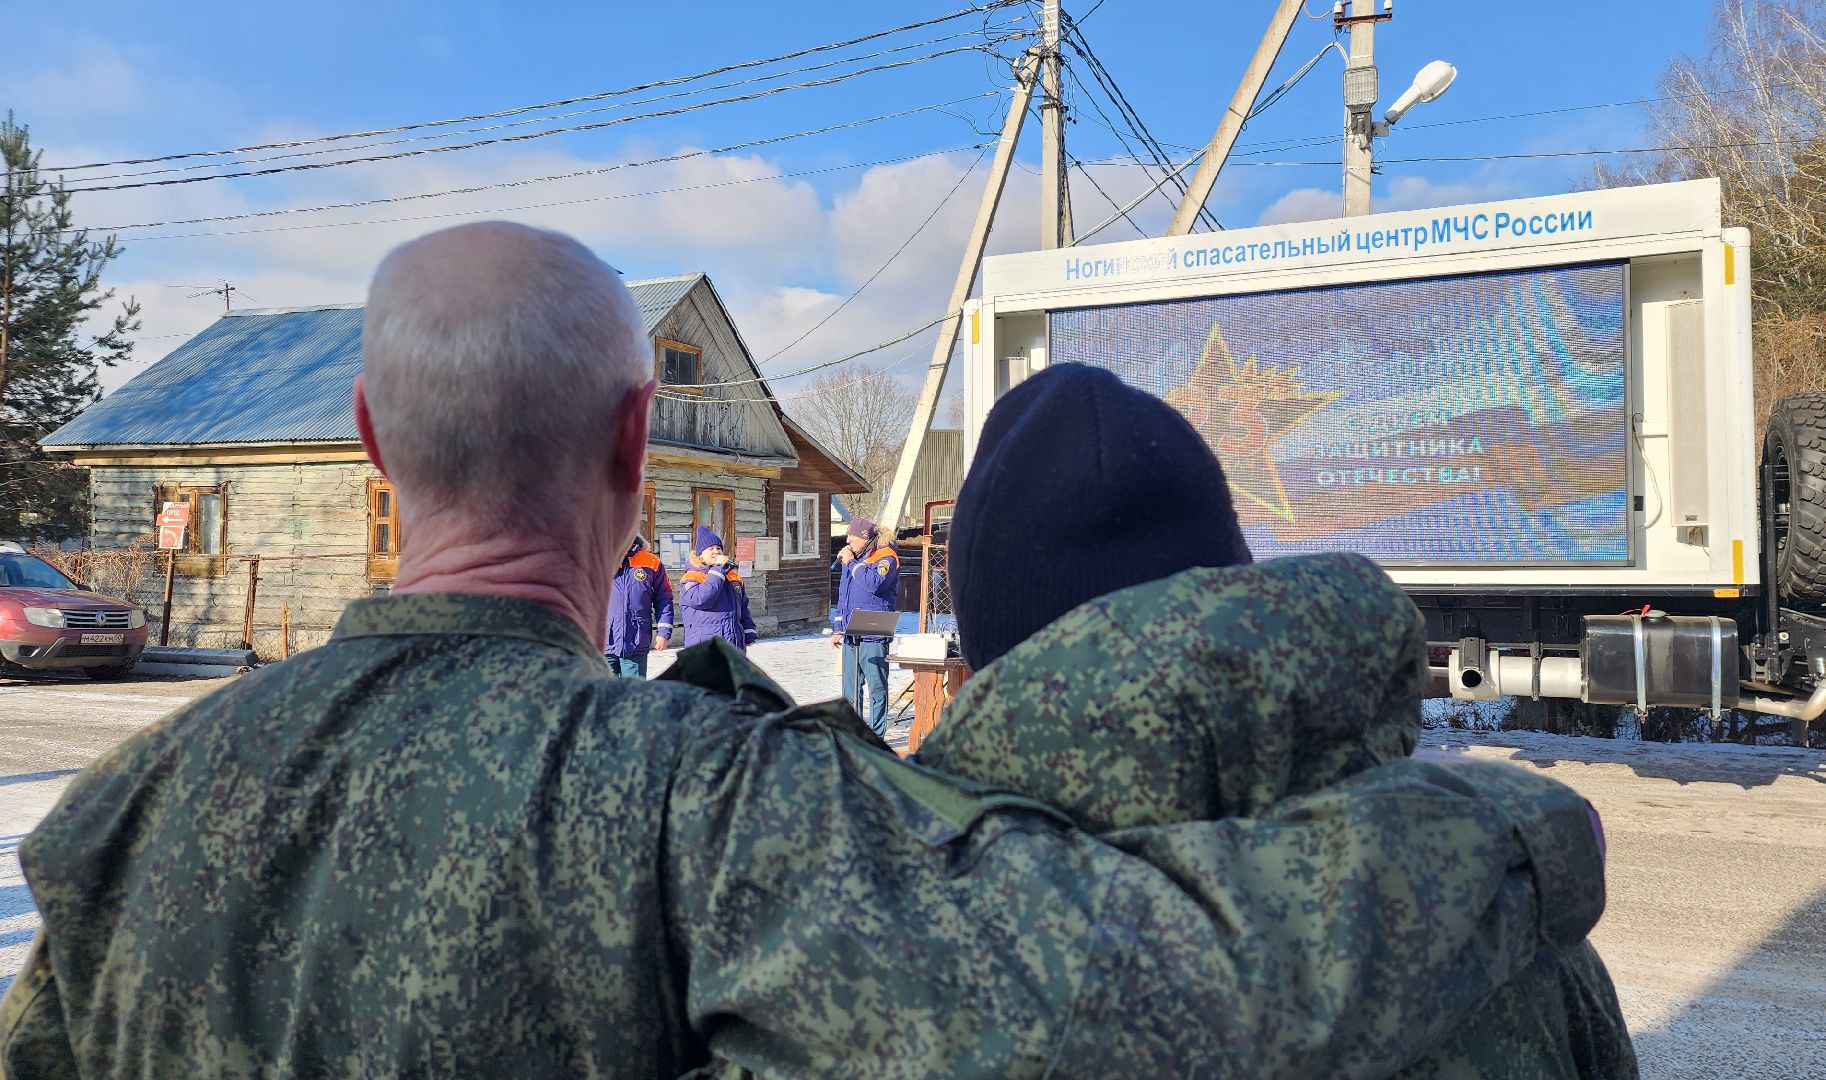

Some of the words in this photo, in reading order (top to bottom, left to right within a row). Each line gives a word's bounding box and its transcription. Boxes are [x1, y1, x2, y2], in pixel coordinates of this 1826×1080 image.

[1066, 247, 1178, 281] Ногинский
[1183, 229, 1352, 269] спасательный
[1356, 224, 1428, 254] центр
[1432, 213, 1489, 244] МЧС
[1495, 209, 1593, 239] России
[1314, 435, 1484, 460] ЗАЩИТНИКА
[1316, 465, 1482, 486] ОТЕЧЕСТВА!
